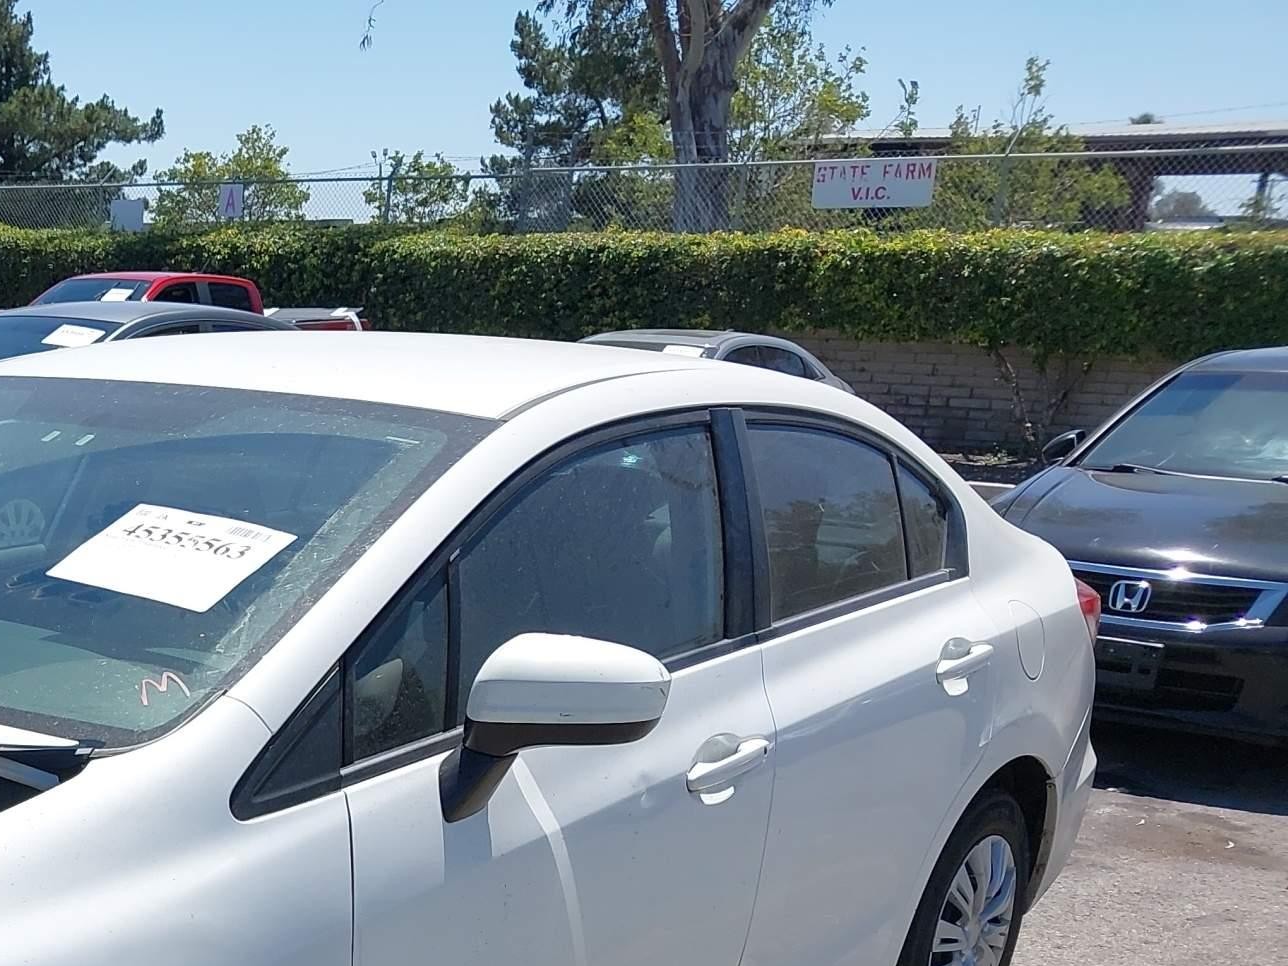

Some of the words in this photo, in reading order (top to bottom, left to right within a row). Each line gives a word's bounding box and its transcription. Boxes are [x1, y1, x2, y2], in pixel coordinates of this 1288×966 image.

[816, 164, 871, 183] STATE
[883, 162, 932, 181] FARM
[224, 187, 236, 213] A
[851, 186, 890, 200] V.I.C.
